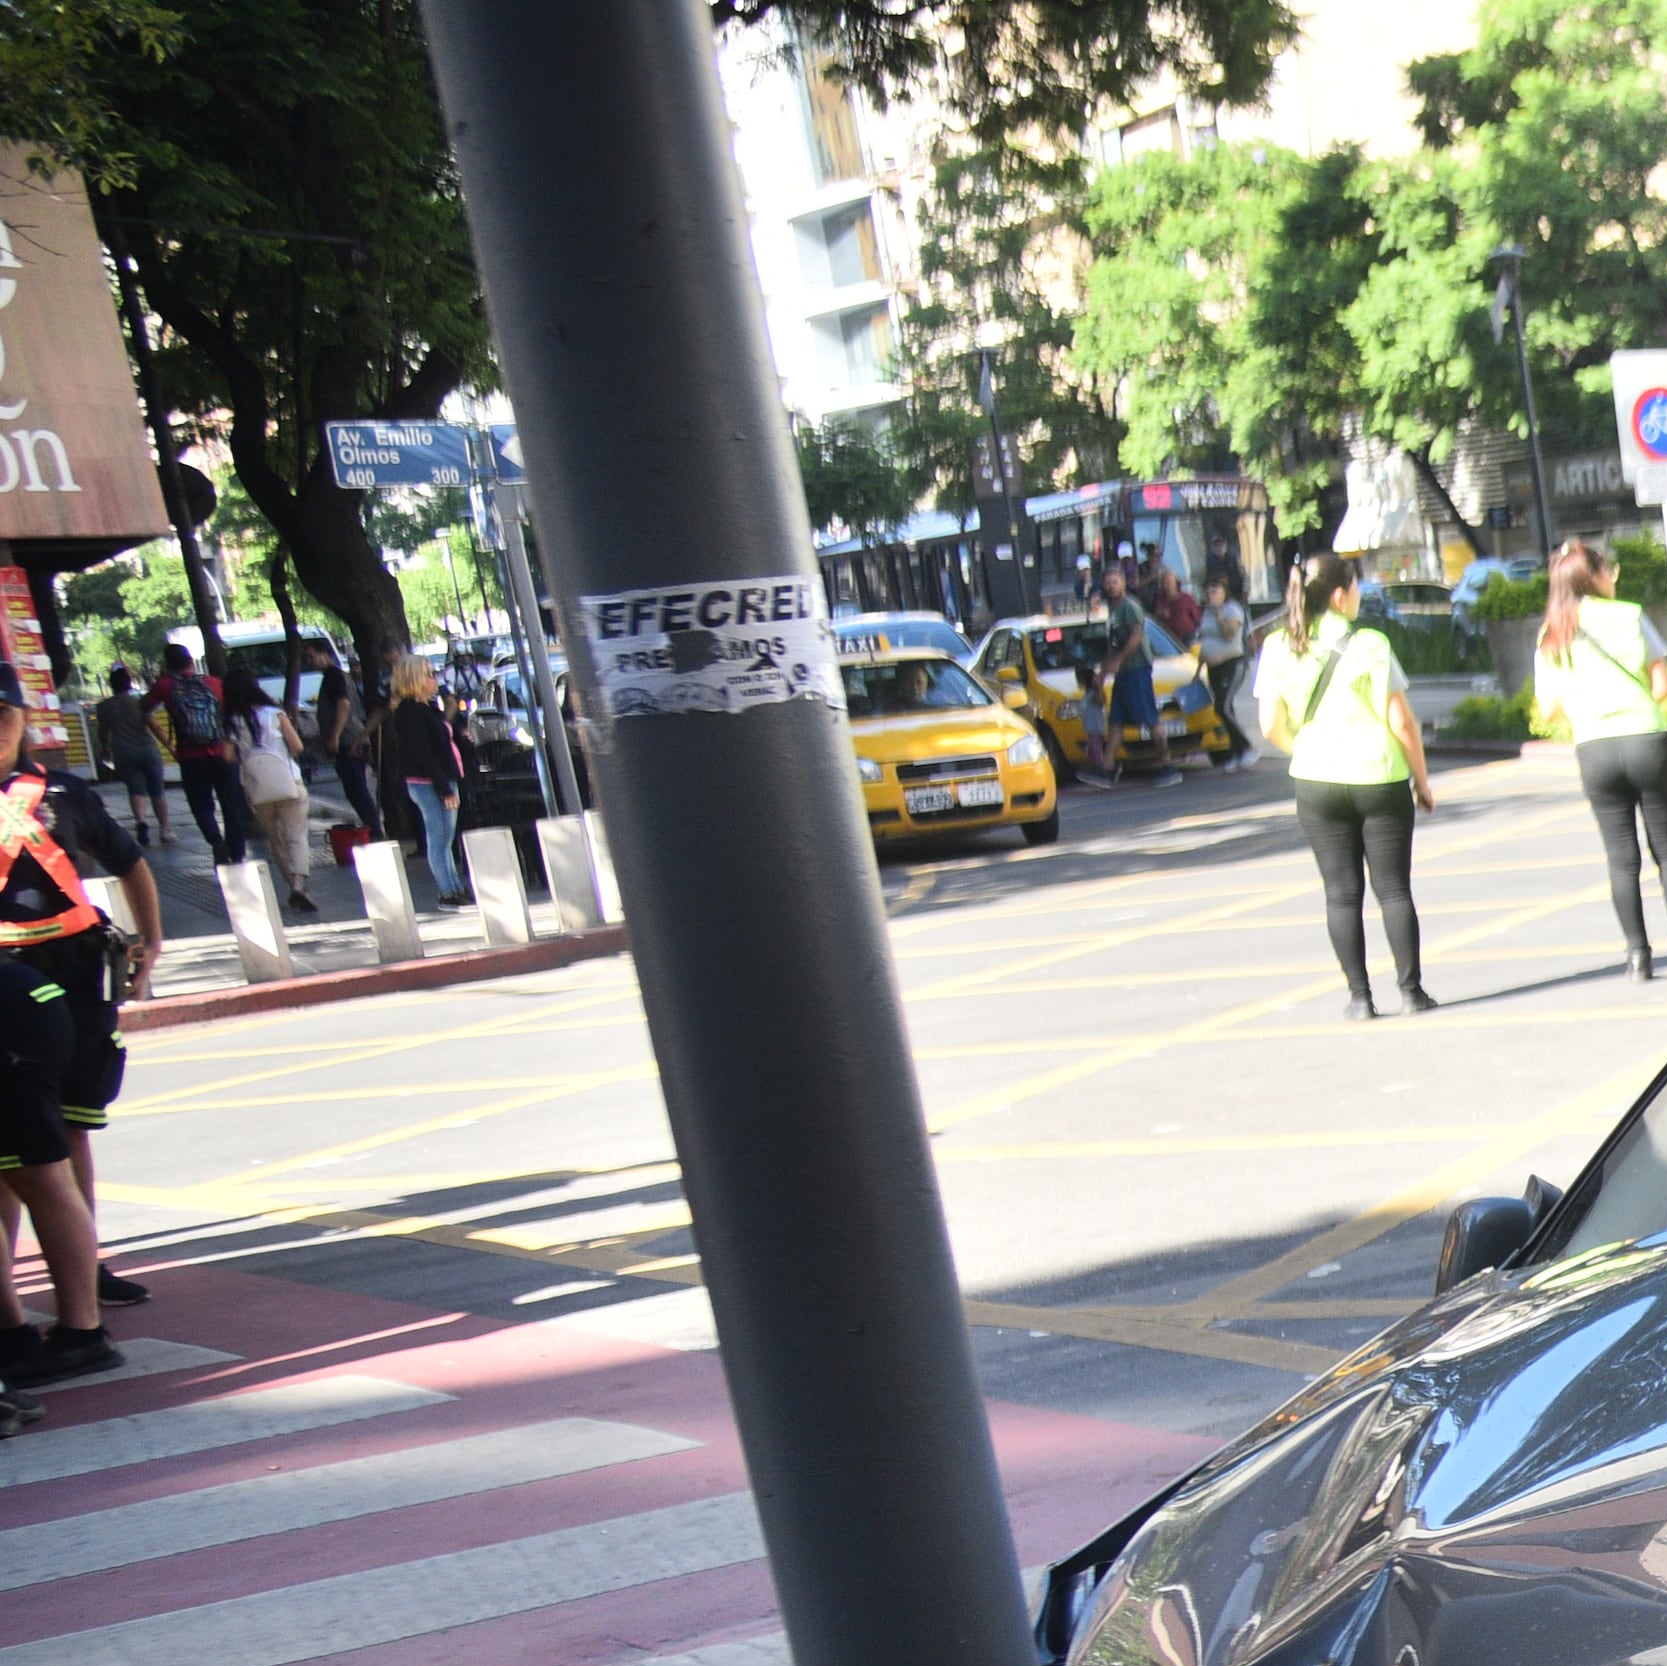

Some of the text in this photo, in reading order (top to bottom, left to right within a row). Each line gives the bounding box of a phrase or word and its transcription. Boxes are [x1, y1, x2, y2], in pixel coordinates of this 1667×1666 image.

[337, 426, 433, 447] Av. Emilio
[339, 447, 401, 466] Olmos
[346, 466, 460, 486] 400 300
[834, 634, 875, 653] TAXI
